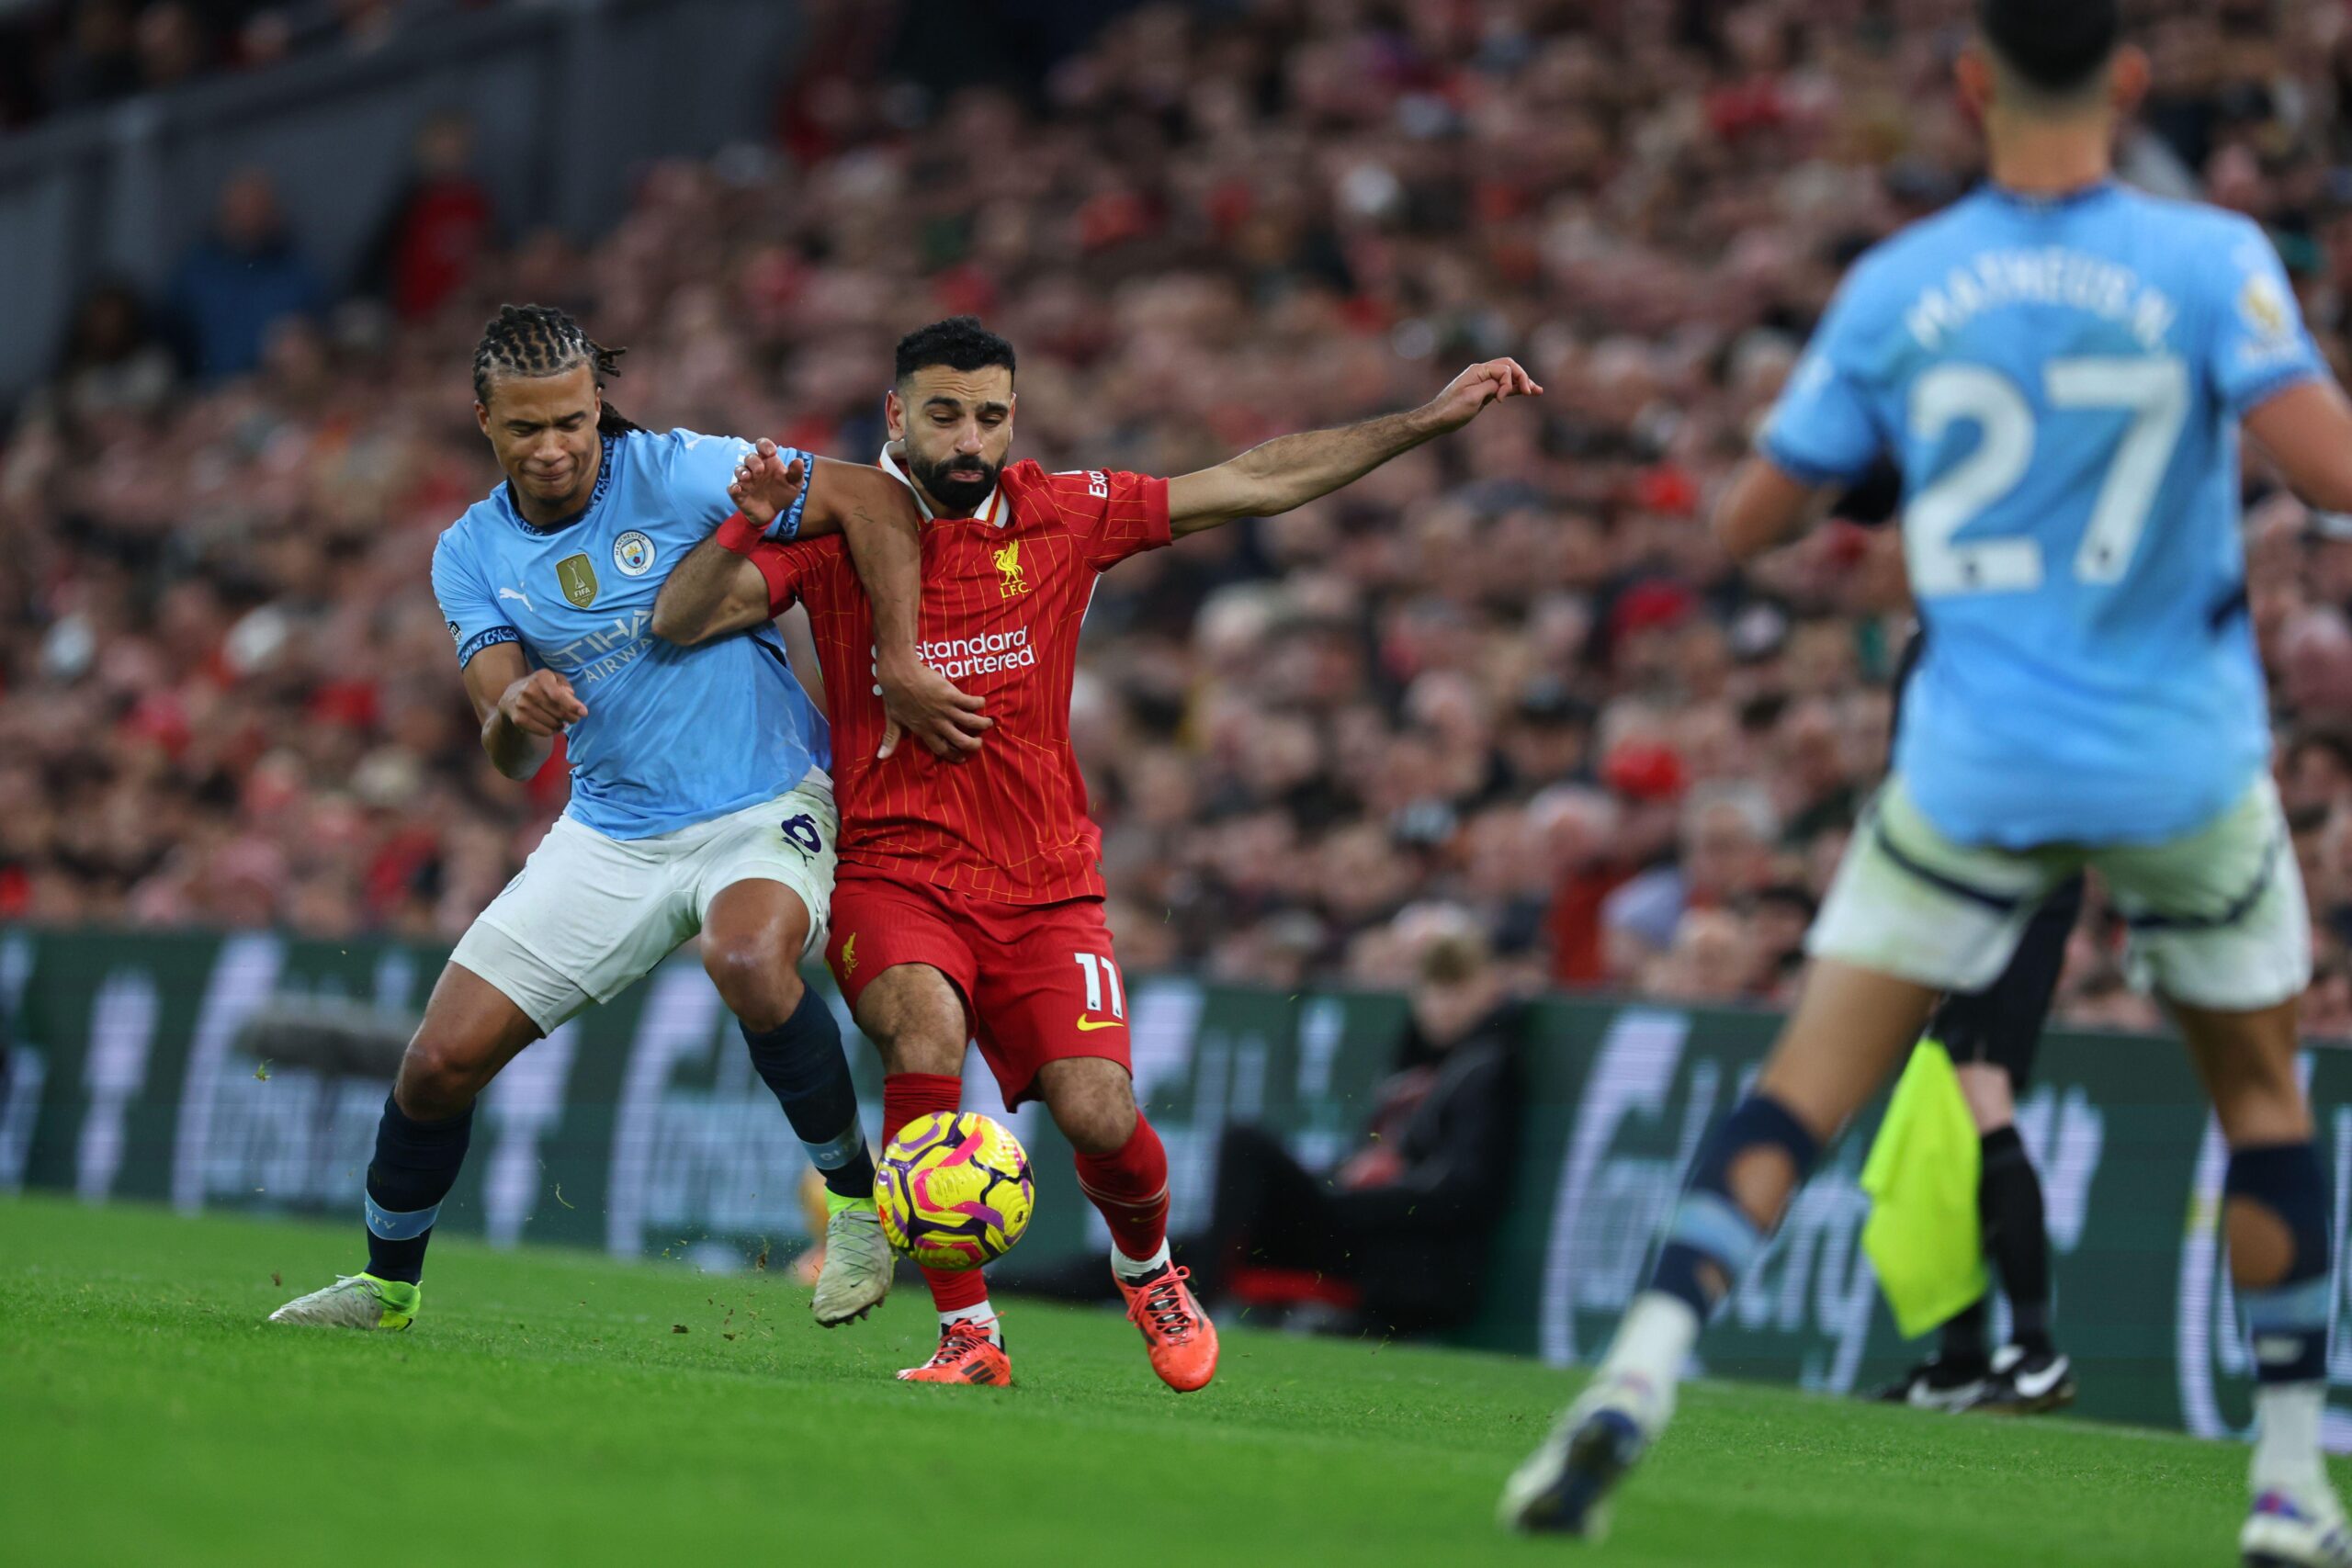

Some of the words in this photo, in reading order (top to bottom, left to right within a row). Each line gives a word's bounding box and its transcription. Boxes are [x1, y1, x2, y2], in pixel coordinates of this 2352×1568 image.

[1087, 470, 1109, 498] Exp
[1902, 355, 2192, 597] 27
[615, 533, 647, 556] MANCHESTER
[573, 587, 591, 598] FIFA
[583, 637, 654, 683] AIRWA
[915, 625, 1027, 661] standard
[928, 644, 1035, 679] hartered
[781, 813, 822, 853] 6
[1073, 952, 1124, 1020] 11
